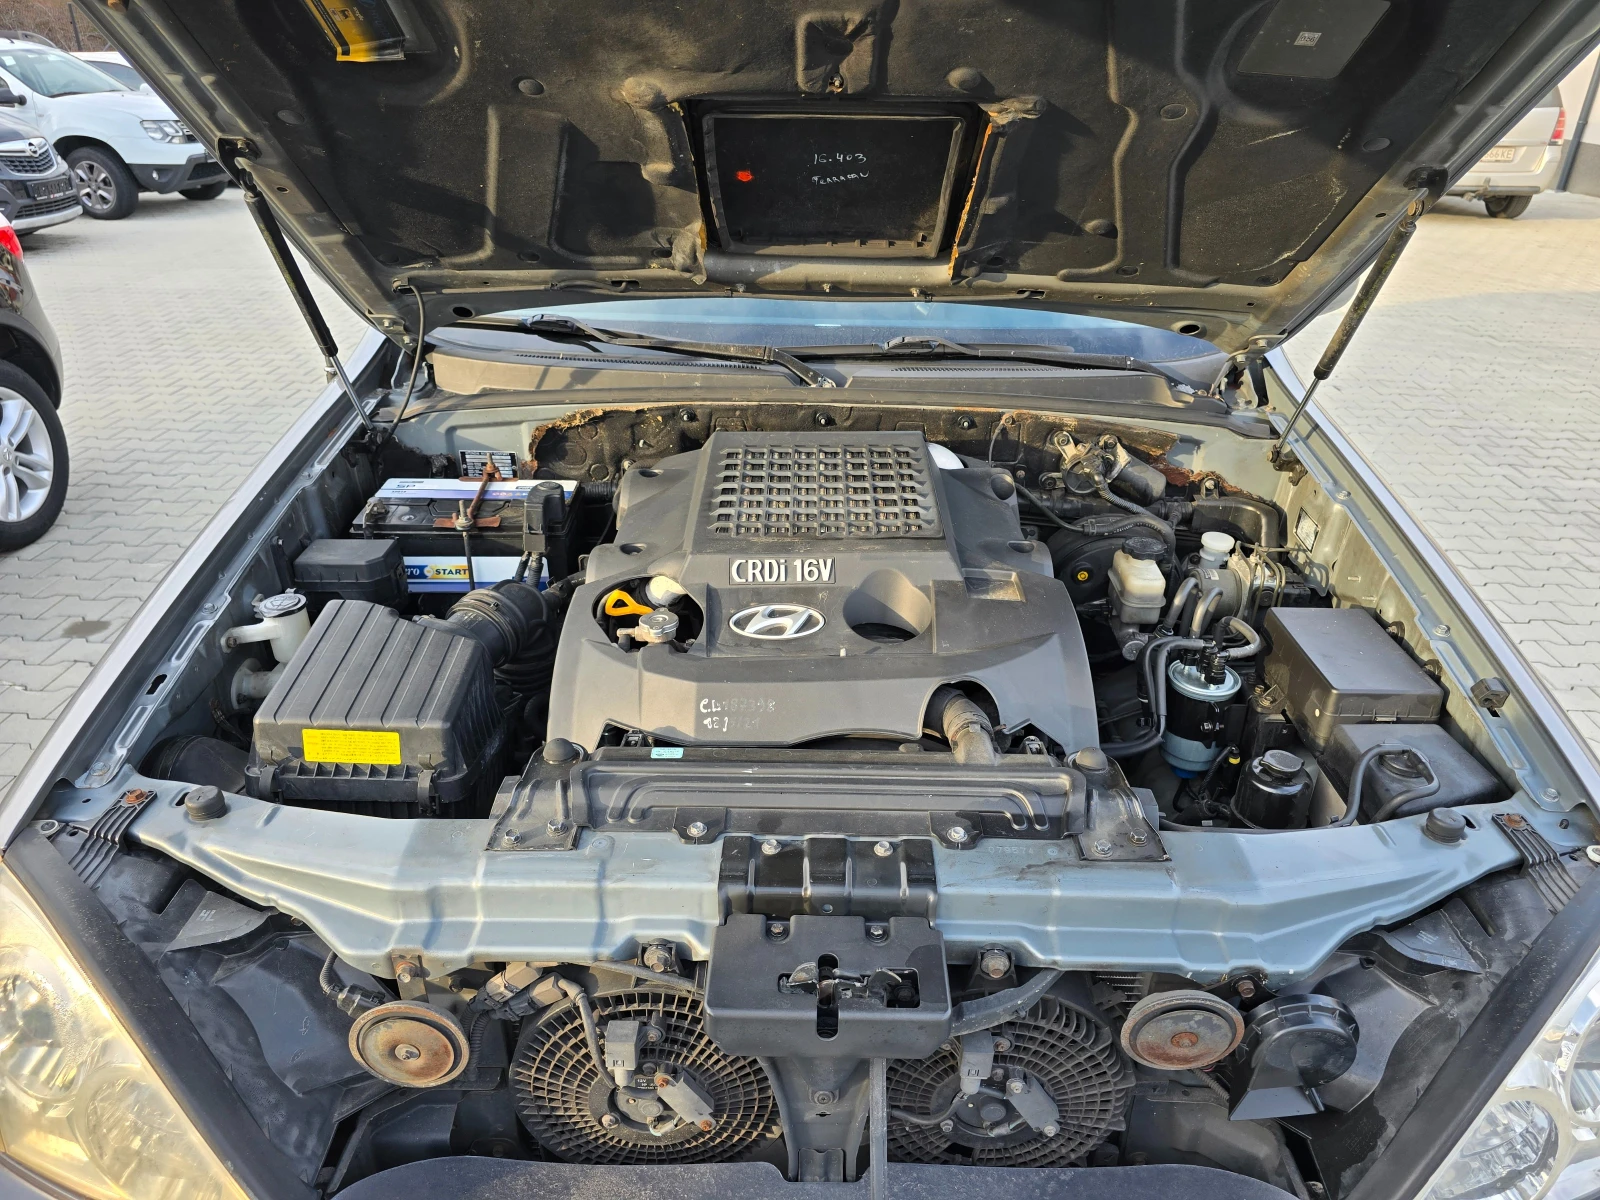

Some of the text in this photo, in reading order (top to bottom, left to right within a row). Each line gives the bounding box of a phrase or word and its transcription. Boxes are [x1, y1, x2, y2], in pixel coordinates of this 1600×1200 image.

[813, 152, 867, 165] 16.403
[435, 568, 469, 576] START
[731, 558, 835, 583] CRDi 16V
